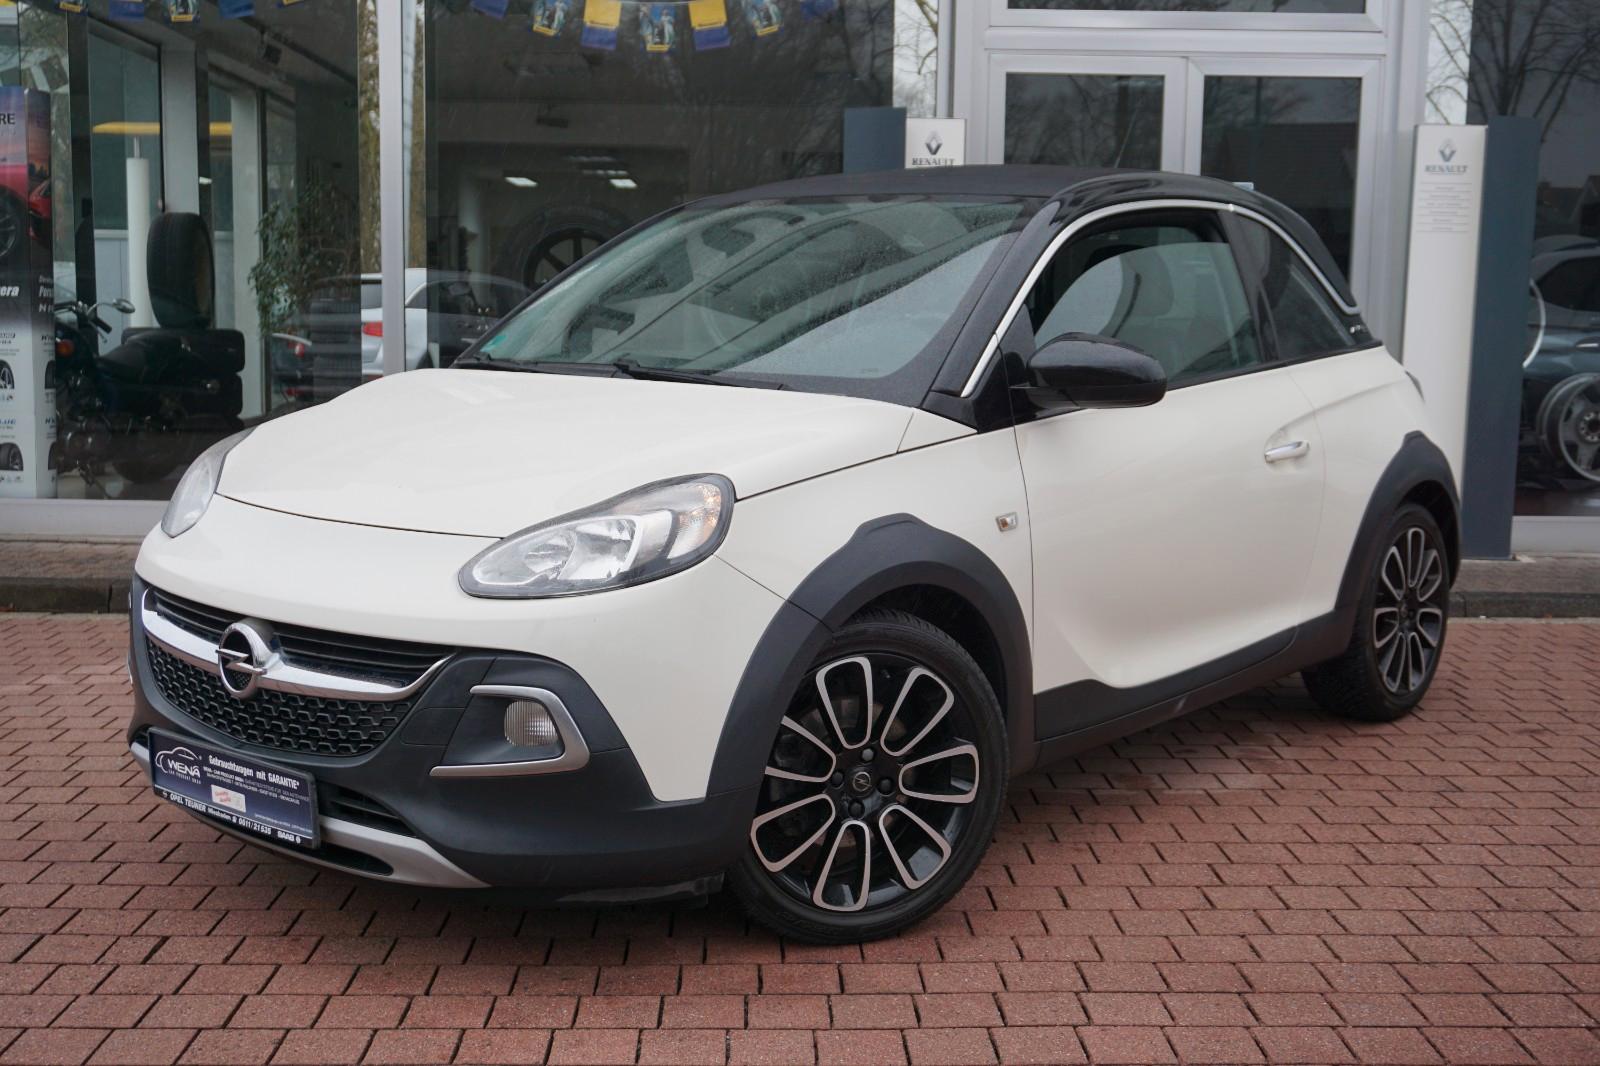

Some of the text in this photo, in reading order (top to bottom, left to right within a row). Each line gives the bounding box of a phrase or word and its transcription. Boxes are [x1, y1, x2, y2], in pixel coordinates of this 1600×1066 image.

[1424, 165, 1468, 173] RENAULT
[208, 754, 254, 777] Gebrauchtwagen
[256, 770, 267, 781] mit
[170, 793, 184, 805] OPEL
